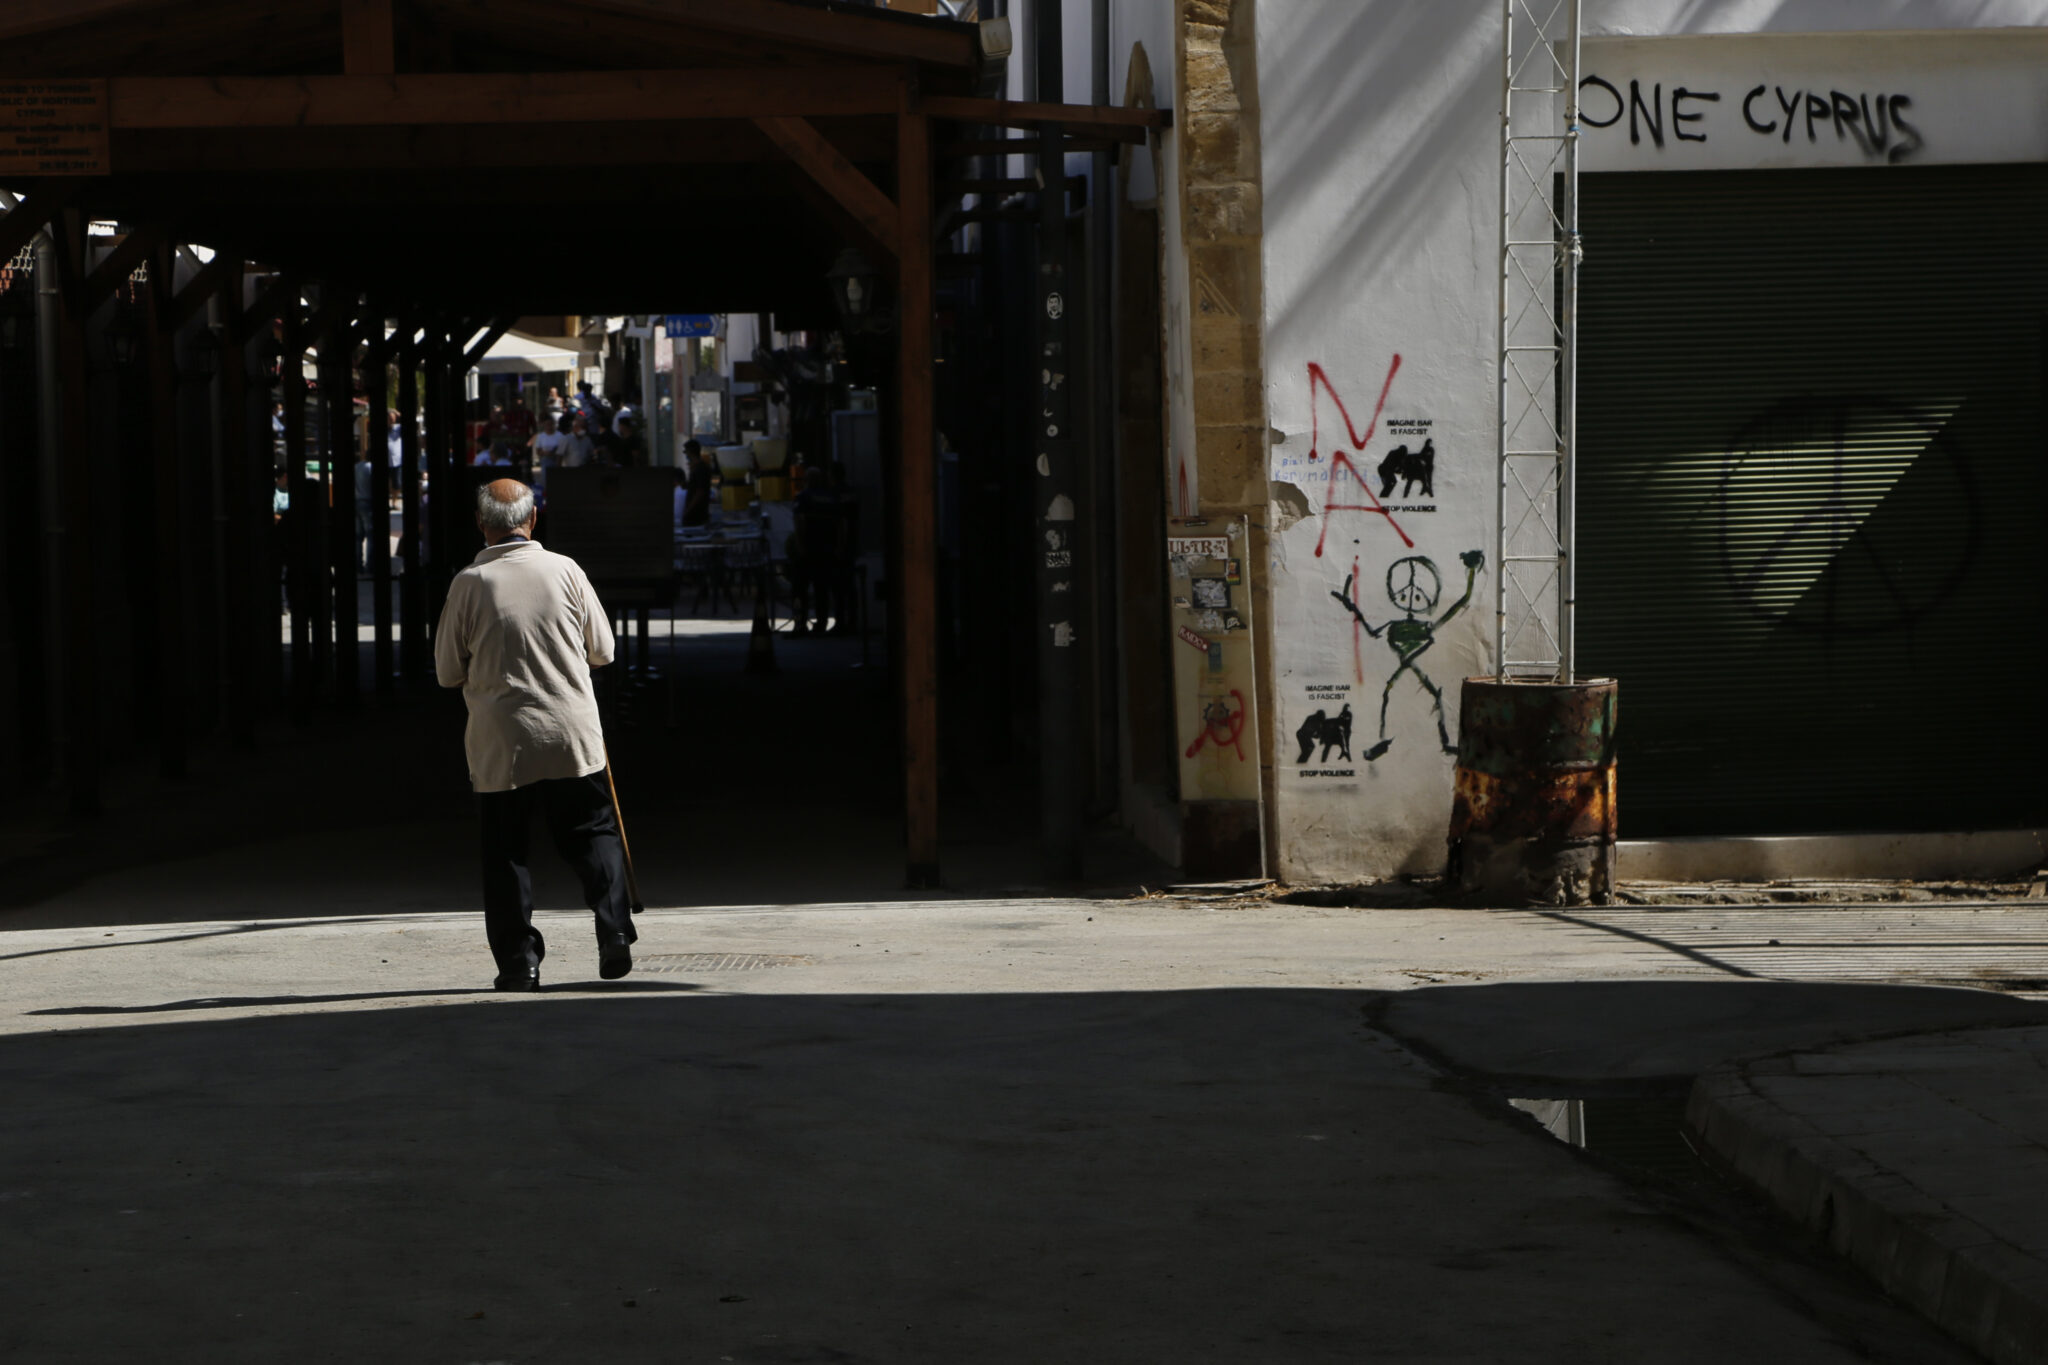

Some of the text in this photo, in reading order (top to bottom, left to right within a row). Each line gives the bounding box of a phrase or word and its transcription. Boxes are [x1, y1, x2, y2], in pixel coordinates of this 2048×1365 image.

[16, 108, 57, 117] CYPRUS
[1577, 75, 1924, 164] ONE CYPRUS
[1387, 419, 1433, 427] IMAGINE BAR
[1382, 505, 1437, 513] STOP VIOLENCE
[1305, 684, 1351, 692] IMAGINE BAR
[1299, 769, 1355, 778] STOP VIOLENCE
